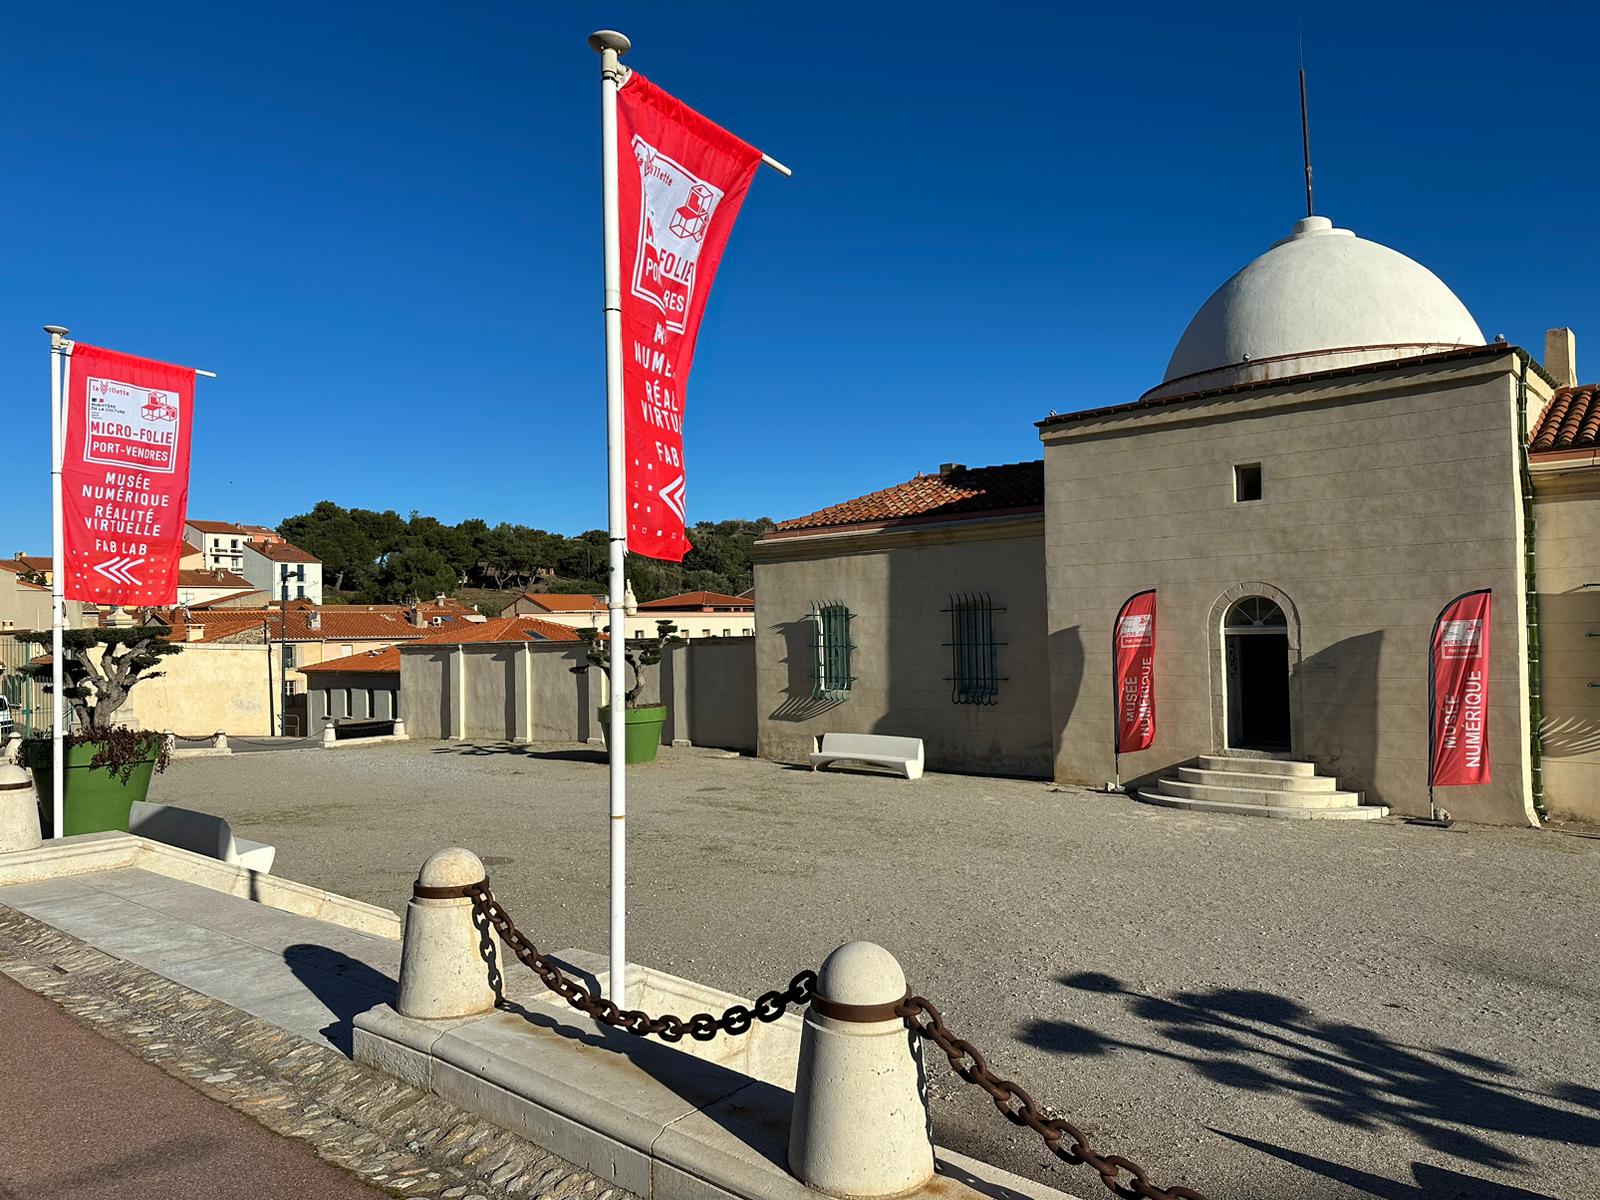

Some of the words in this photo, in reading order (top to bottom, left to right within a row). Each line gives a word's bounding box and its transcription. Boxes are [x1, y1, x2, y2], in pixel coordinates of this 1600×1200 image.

[91, 420, 173, 444] MICRO-FOLIE
[93, 441, 169, 462] PORT-VENDRES
[655, 440, 680, 467] FAB
[105, 472, 151, 491] MUSÉE
[82, 484, 169, 507] NUMÉRIQUE
[95, 503, 154, 524] RÉALITÉ
[84, 517, 161, 537] VIRTUELLE
[95, 538, 117, 554] FAB
[122, 541, 148, 556] LAB
[1462, 670, 1482, 768] NUMÉRIQUE
